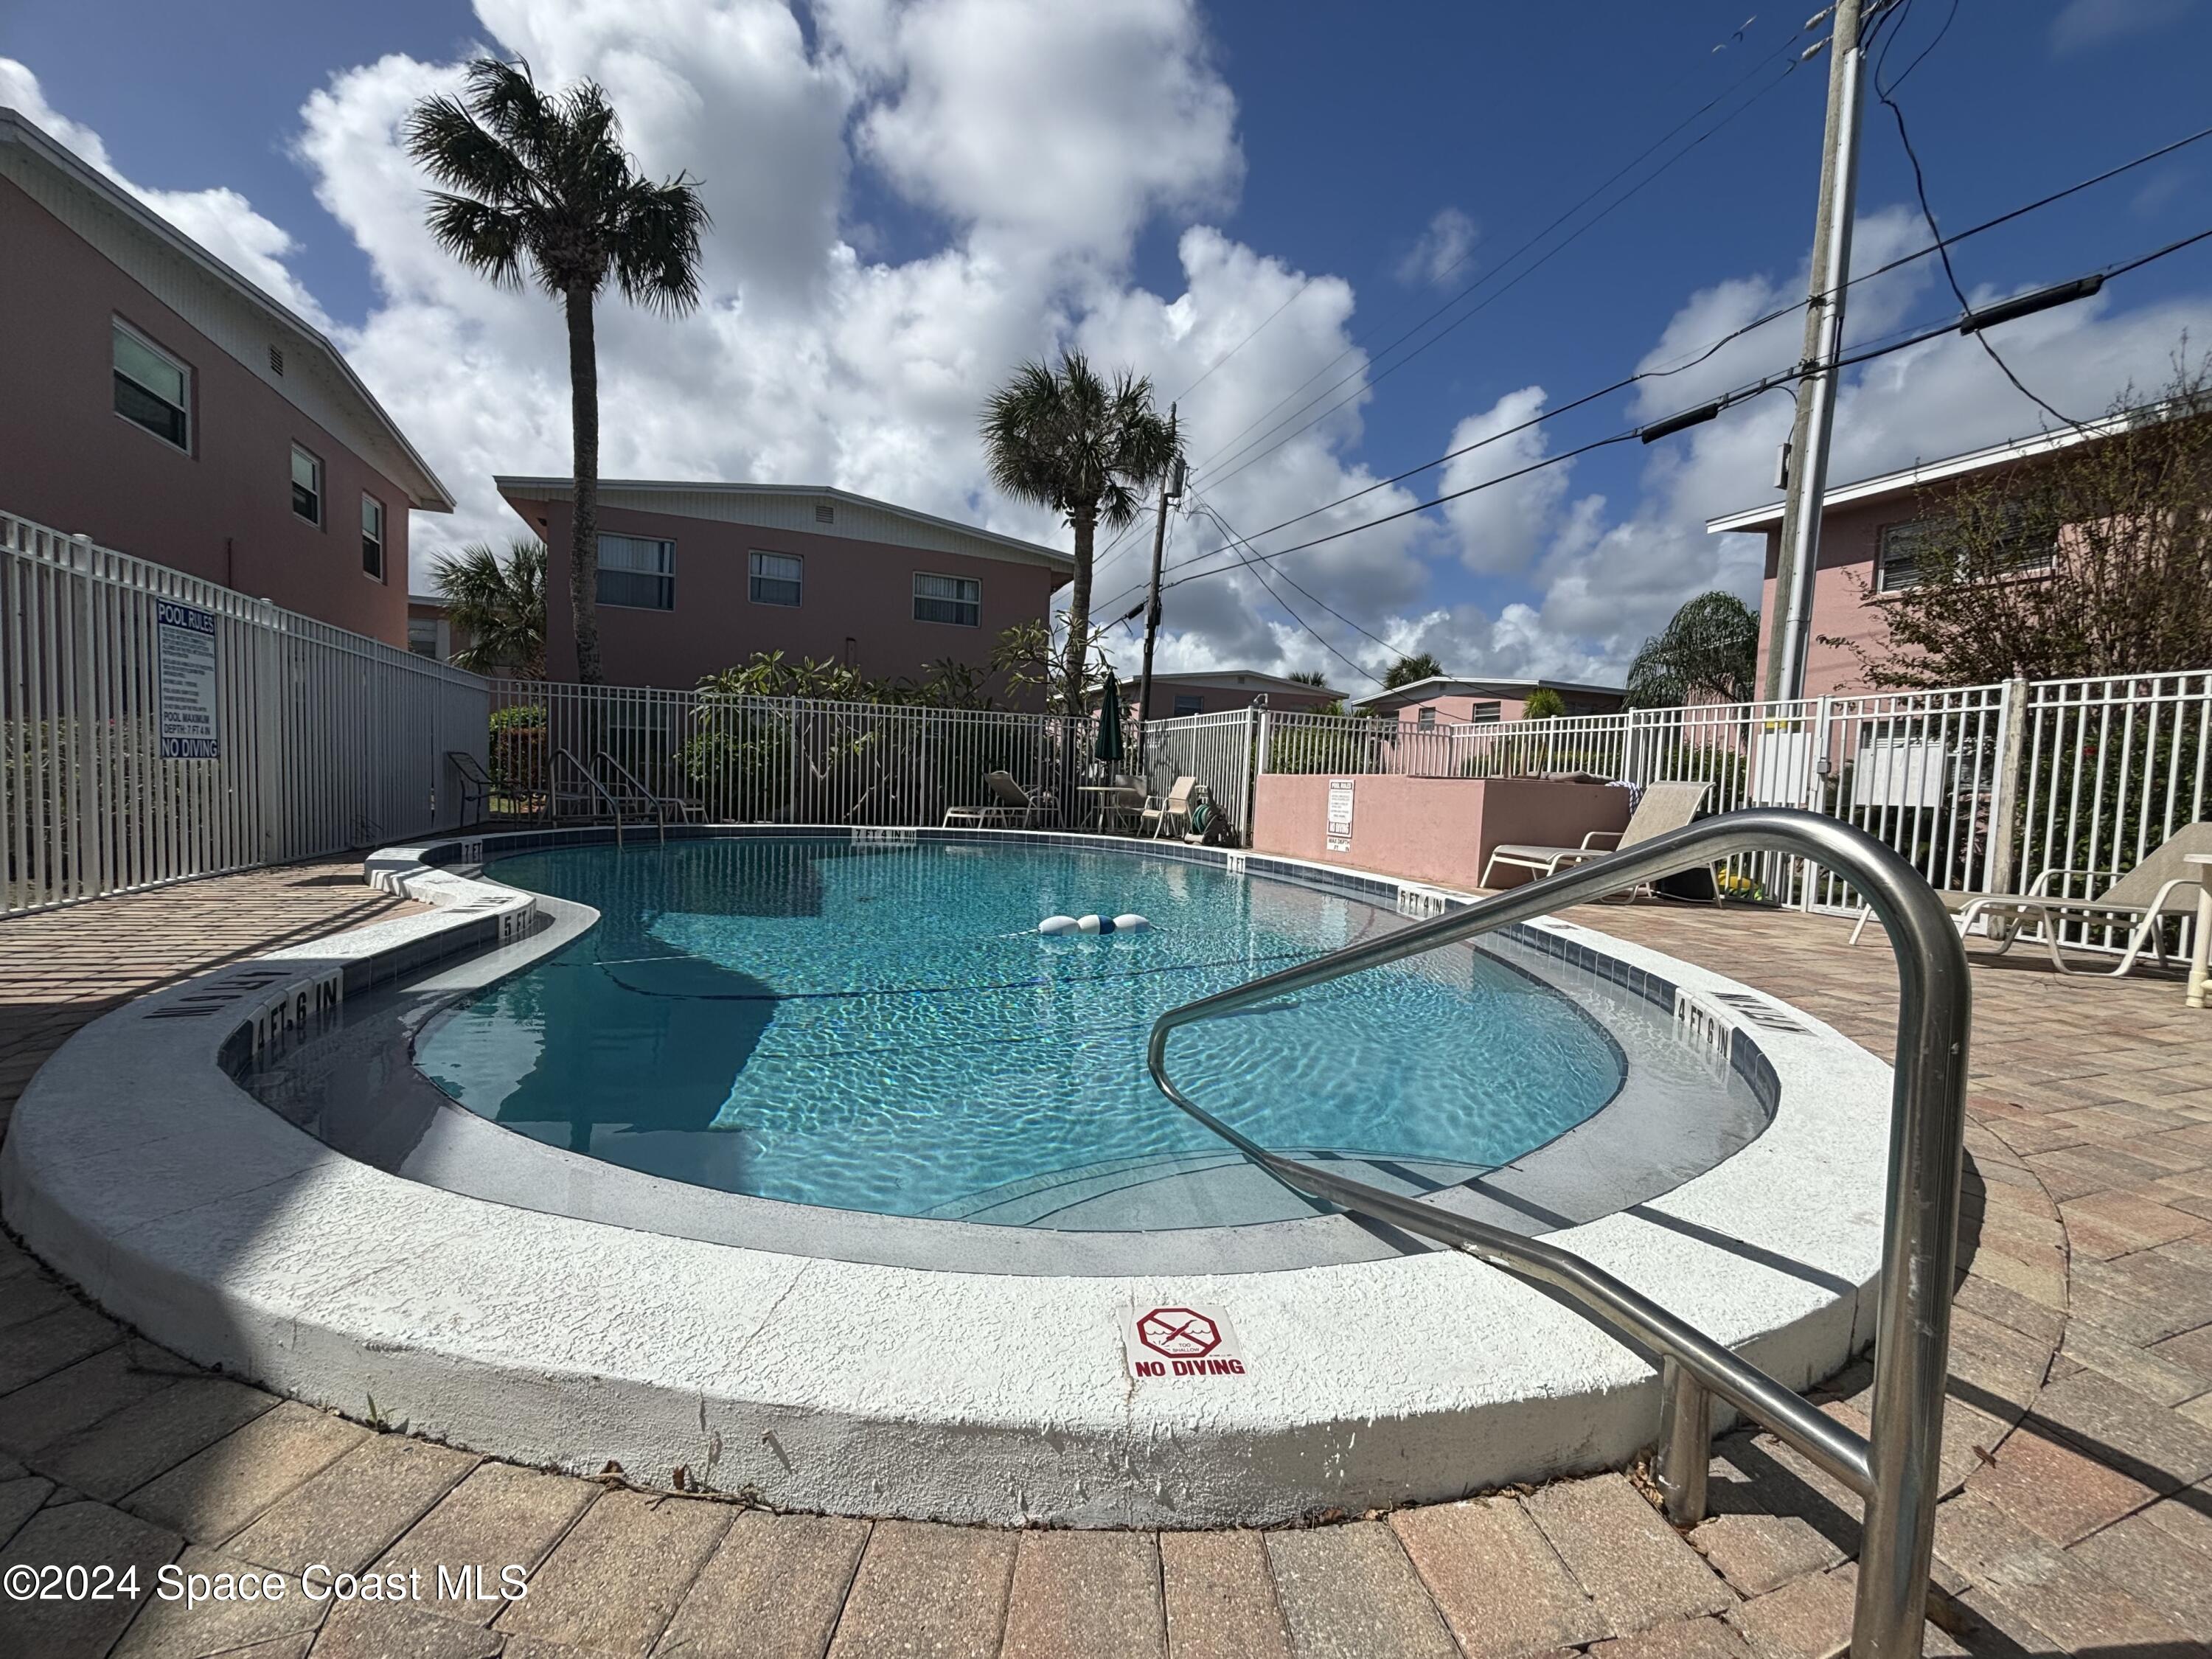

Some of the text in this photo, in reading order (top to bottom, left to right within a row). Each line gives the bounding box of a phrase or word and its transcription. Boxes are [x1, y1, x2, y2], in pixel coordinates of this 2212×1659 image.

[159, 603, 214, 633] POOL RULES
[164, 712, 209, 723] POOL MAXIMUM
[187, 726, 191, 734] 7
[192, 726, 199, 734] FT
[200, 726, 204, 734] 4
[205, 726, 211, 735] IN
[162, 738, 218, 757] NO DIVING
[905, 830, 915, 838] MAX
[473, 843, 481, 855] FT
[1400, 891, 1405, 905] 5
[1409, 893, 1419, 908] FT
[1424, 896, 1429, 908] 4
[1433, 897, 1442, 912] IN
[504, 916, 511, 936] 5
[517, 910, 526, 932] FT
[258, 1018, 265, 1050] 4
[296, 992, 307, 1020] 6
[316, 977, 337, 1012] IN
[1678, 998, 1729, 1060] 4 FT 6 IN
[1135, 1359, 1245, 1377] NO DIVING
